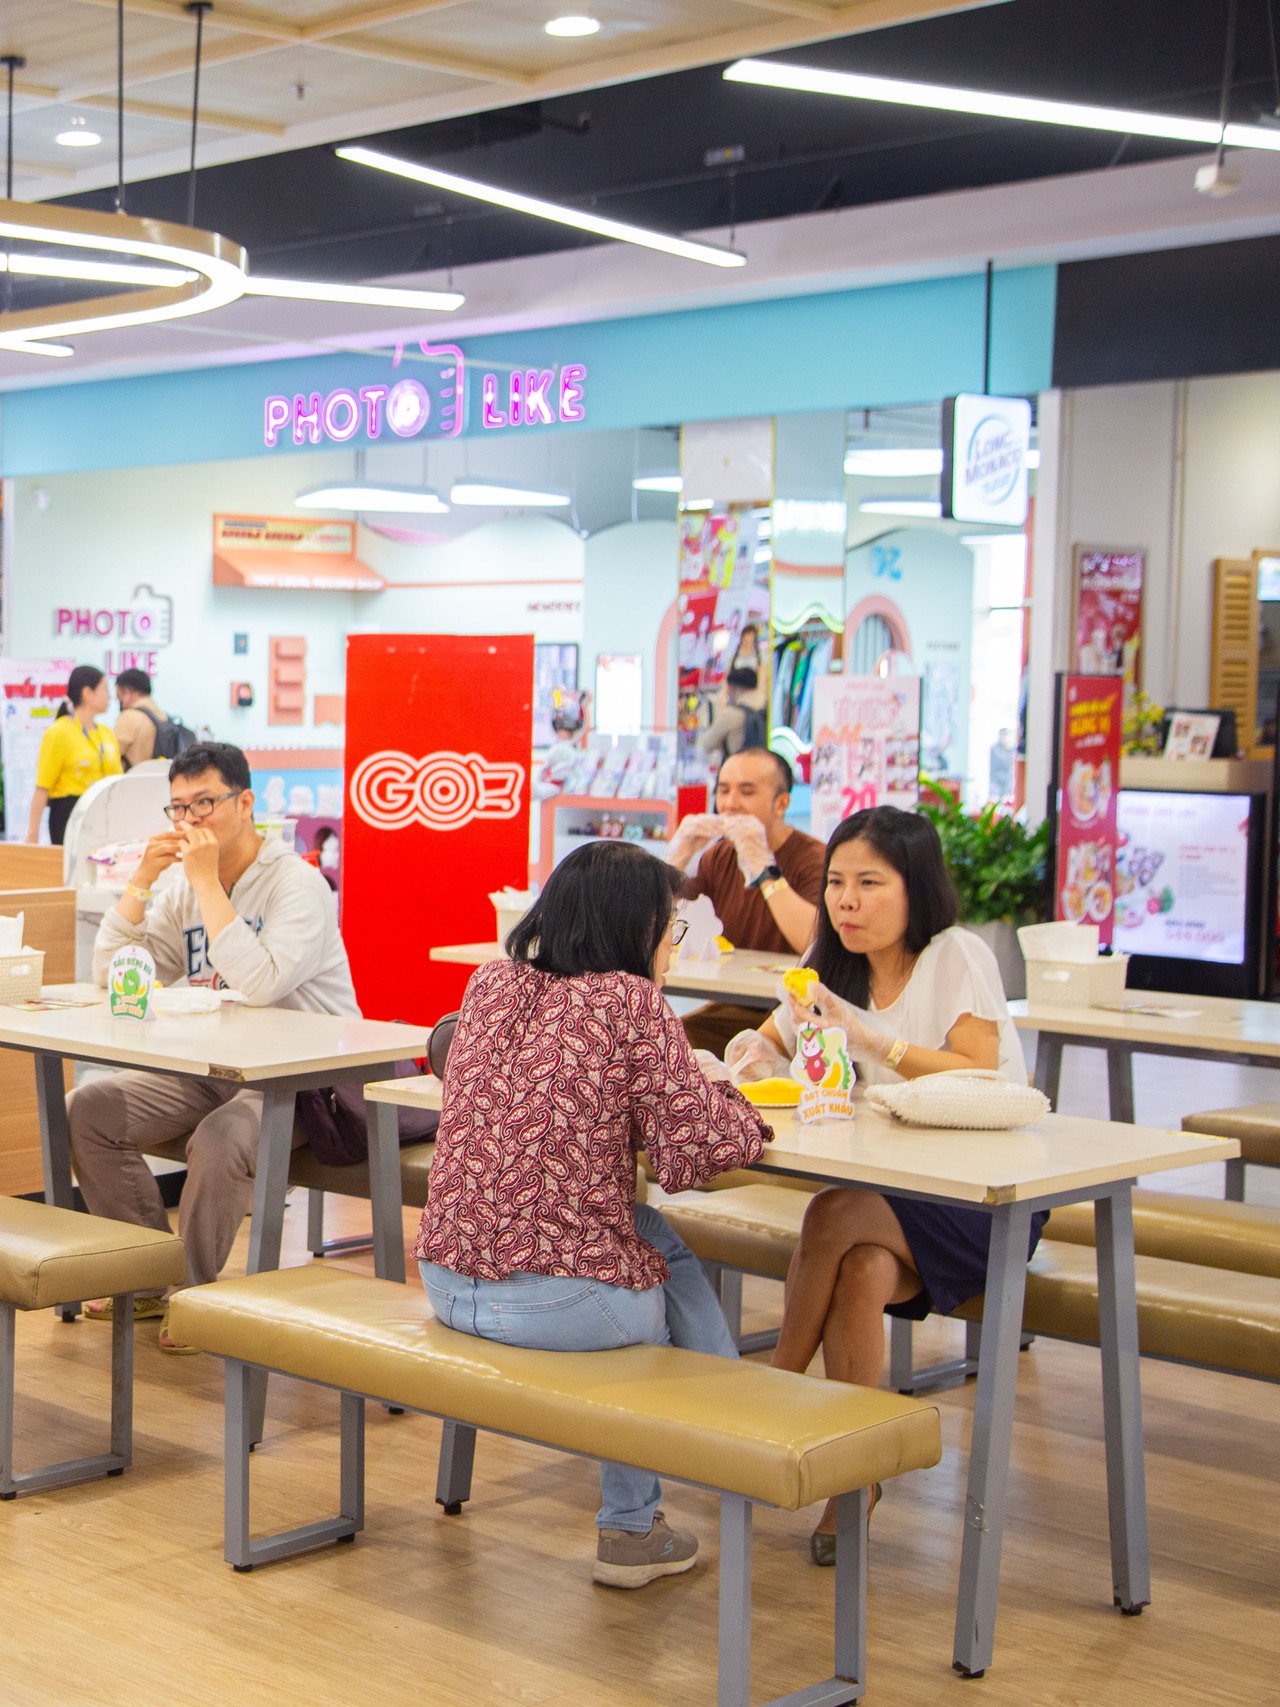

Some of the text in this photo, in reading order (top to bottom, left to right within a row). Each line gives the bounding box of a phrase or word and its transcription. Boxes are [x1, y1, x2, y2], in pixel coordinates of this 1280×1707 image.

[264, 364, 586, 447] PHOTO LIKE
[57, 609, 151, 637] PHOTO
[108, 651, 158, 677] LIKE
[803, 1099, 854, 1119] XUẤT KHẨU
